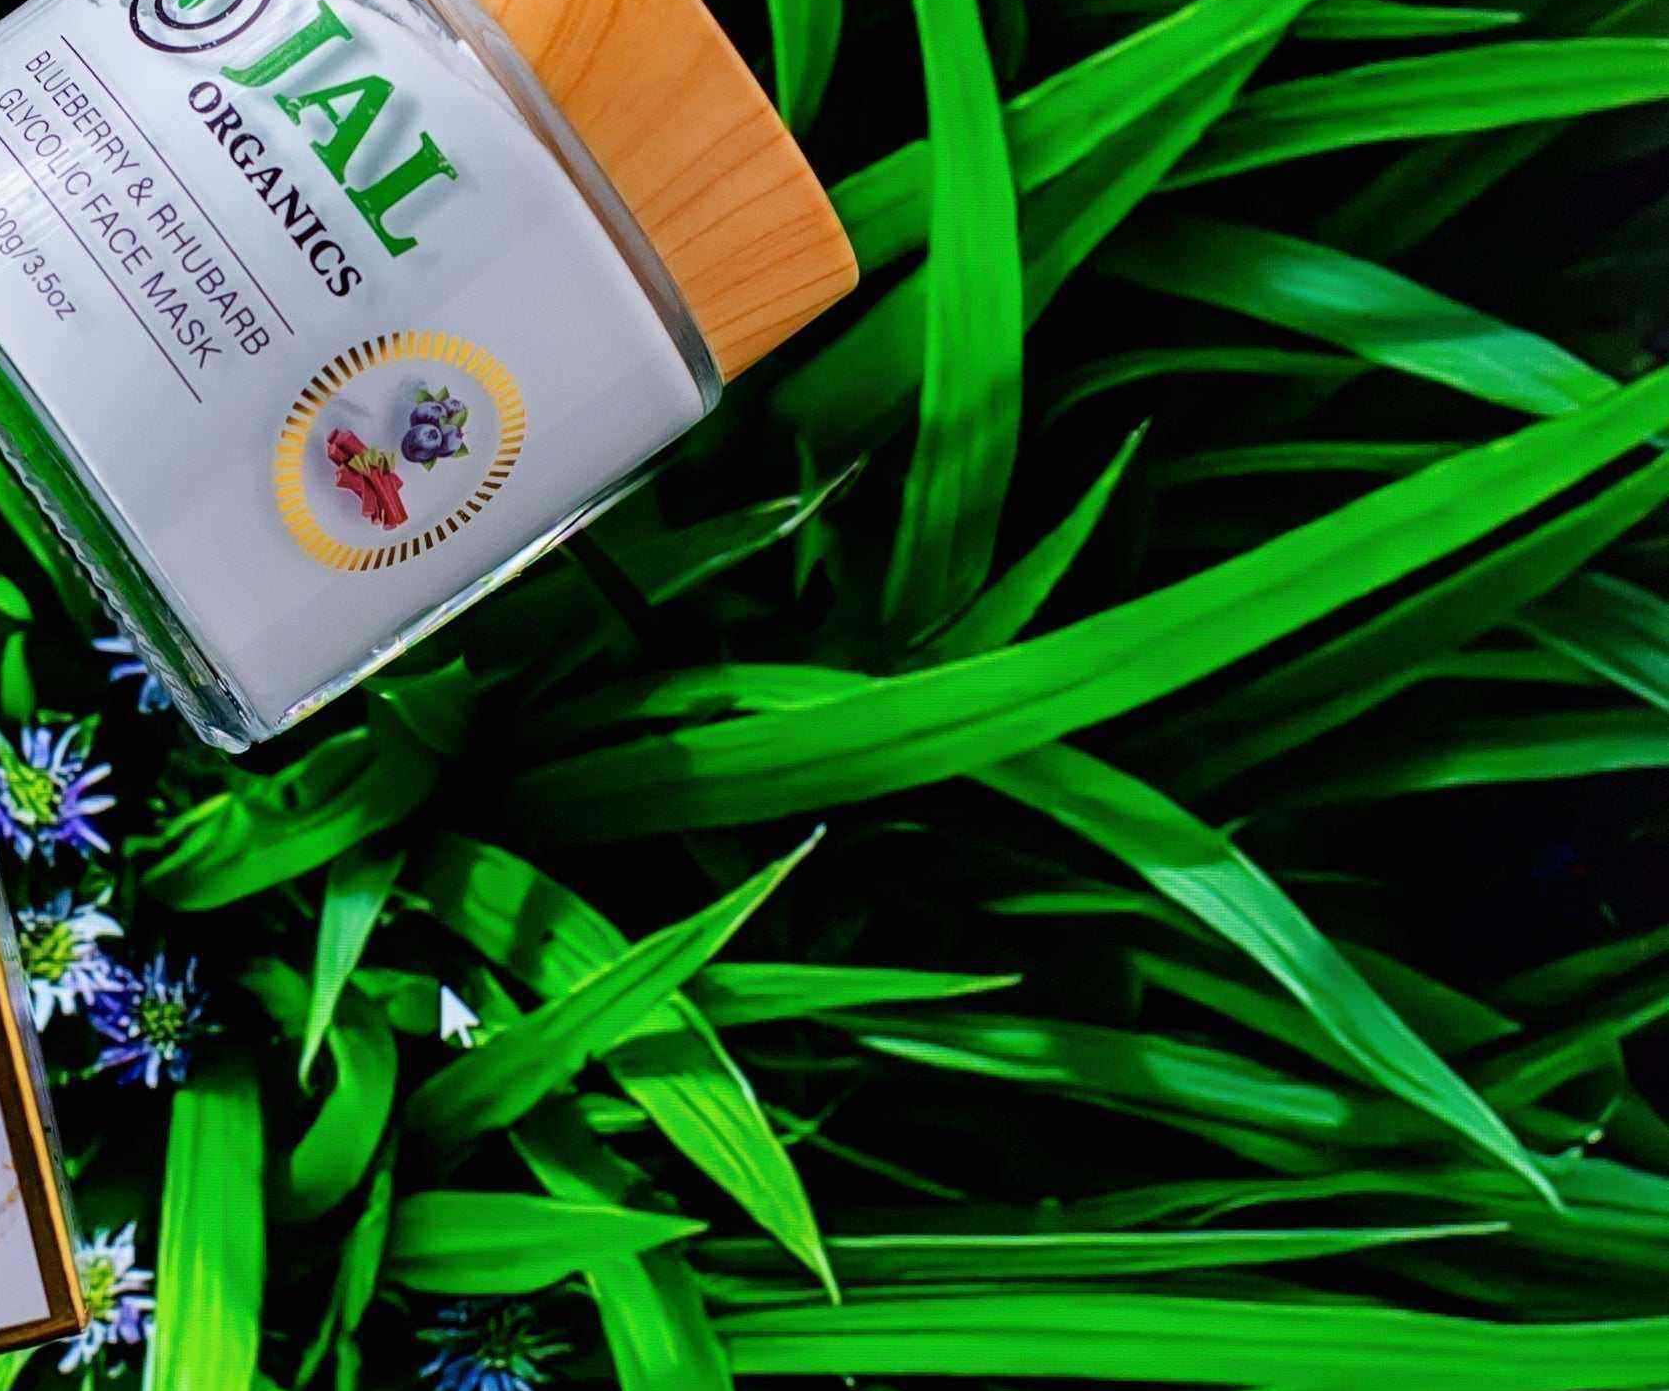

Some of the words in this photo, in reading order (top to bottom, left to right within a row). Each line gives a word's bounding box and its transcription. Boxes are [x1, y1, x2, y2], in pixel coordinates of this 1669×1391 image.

[24, 50, 140, 177] BLUEBERRY
[127, 175, 154, 204] &
[147, 201, 272, 356] RHUBARB
[187, 80, 365, 299] ORGANICS
[221, 0, 460, 258] JAL
[83, 193, 153, 275] FACE
[139, 269, 224, 369] MASK
